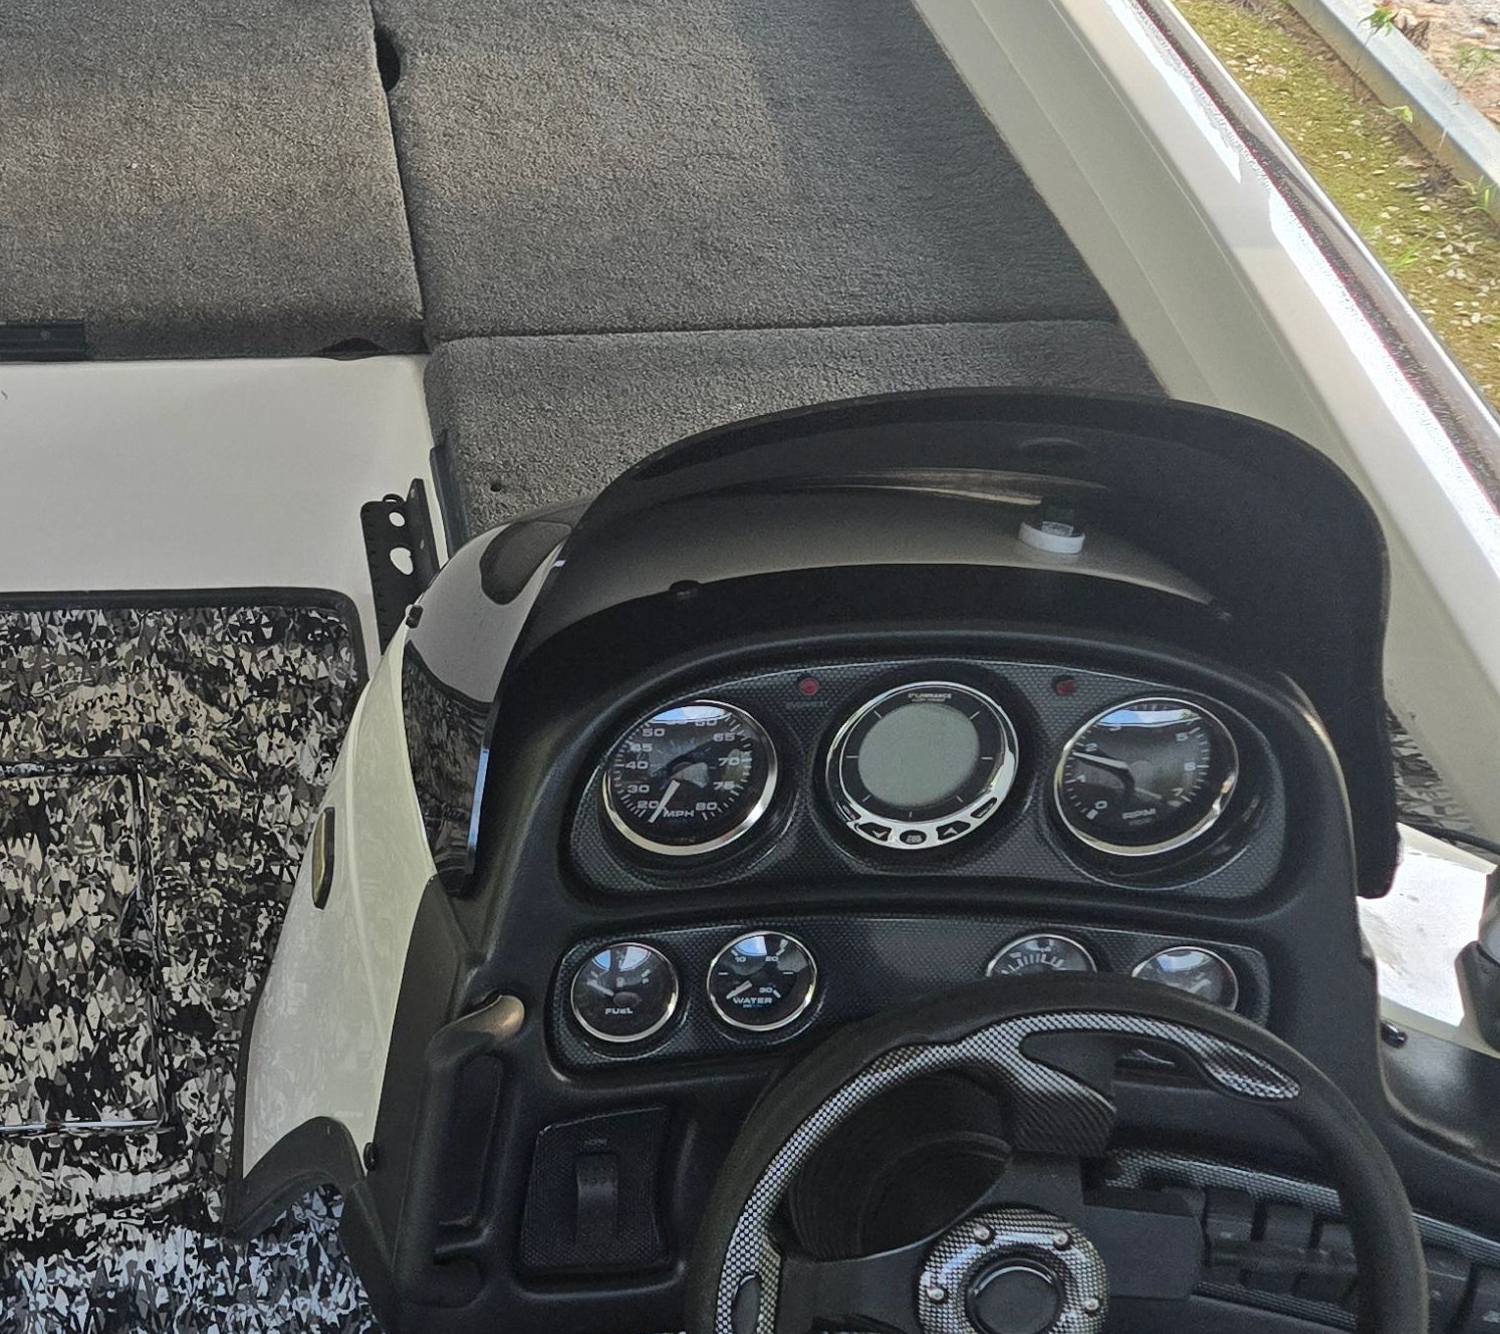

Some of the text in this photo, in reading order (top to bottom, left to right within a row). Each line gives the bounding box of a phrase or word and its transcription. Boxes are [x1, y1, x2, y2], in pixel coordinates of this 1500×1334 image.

[642, 728, 665, 737] 50
[713, 732, 736, 742] 65
[1175, 732, 1189, 742] 5
[630, 743, 653, 752] 45
[1085, 742, 1098, 753] 2
[625, 760, 649, 770] 40
[718, 757, 740, 766] 70
[627, 784, 650, 794] 30
[713, 781, 735, 790] 75
[637, 800, 659, 810] 20
[695, 802, 718, 811] 80
[663, 809, 695, 818] MPH
[1121, 807, 1157, 820] RPM
[734, 956, 747, 964] 10
[604, 1007, 634, 1015] FUEL
